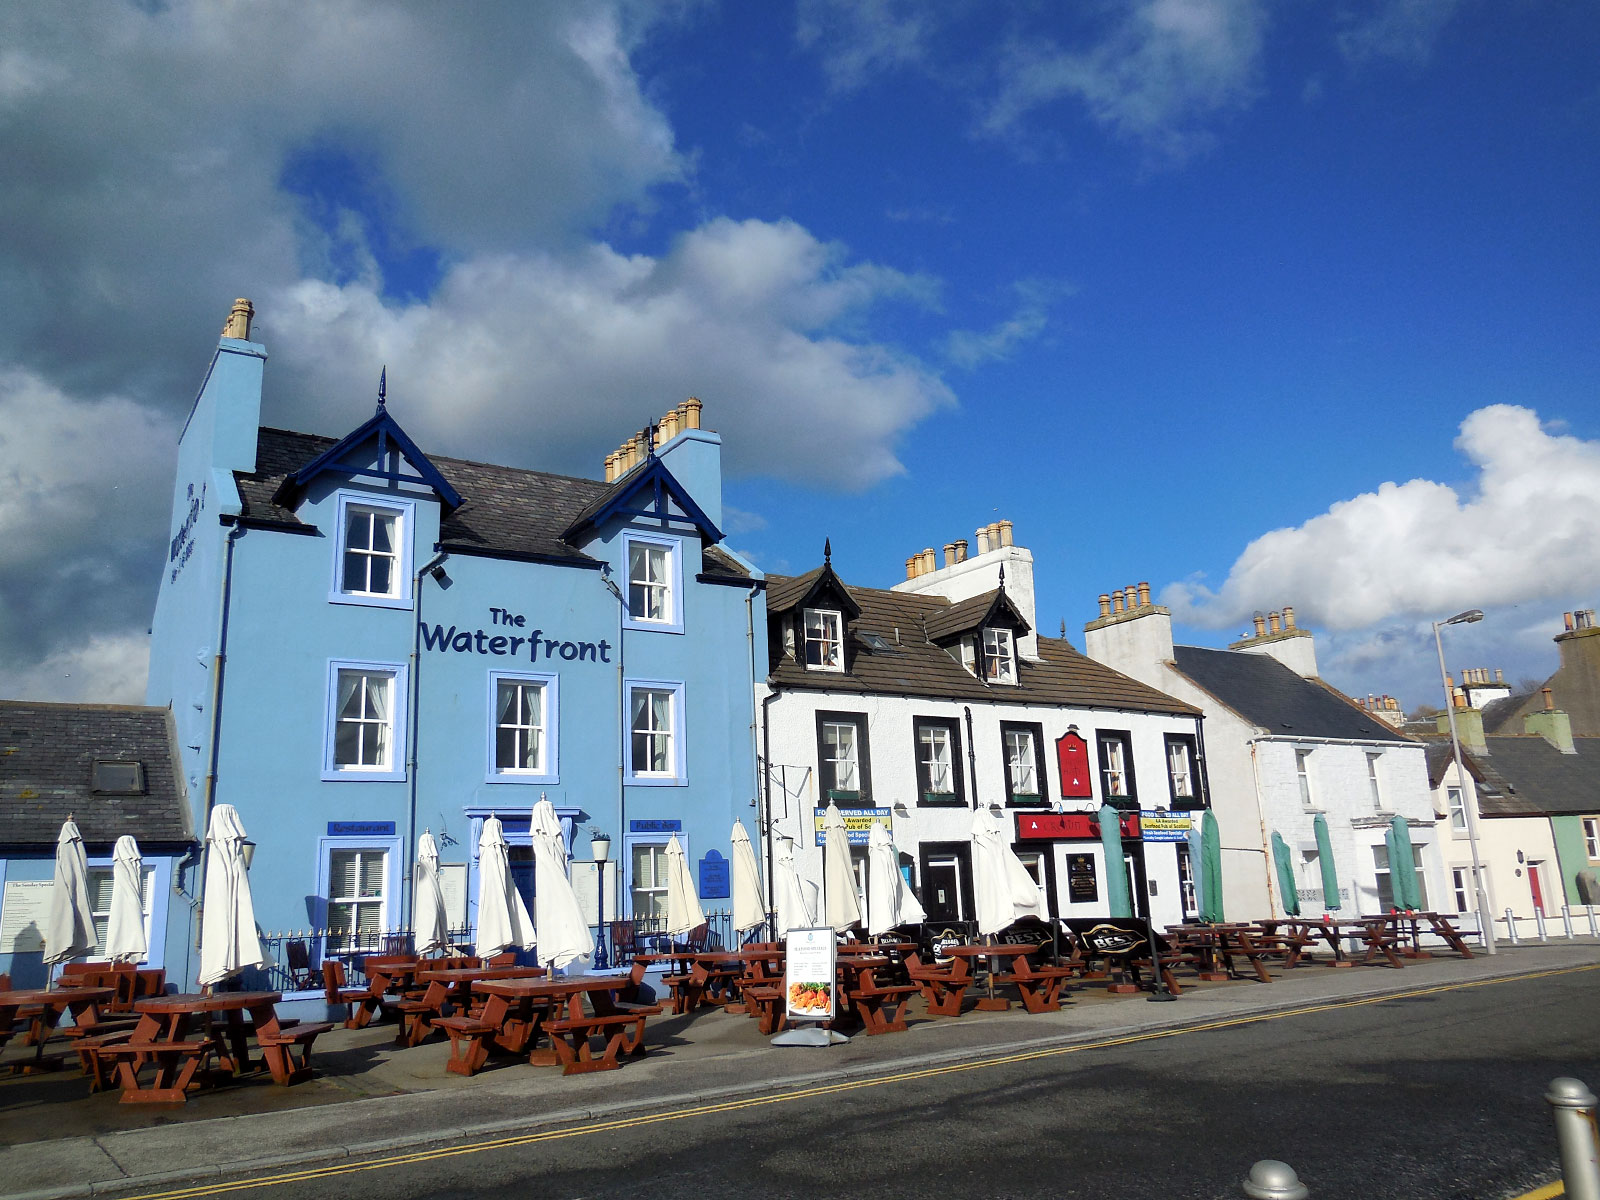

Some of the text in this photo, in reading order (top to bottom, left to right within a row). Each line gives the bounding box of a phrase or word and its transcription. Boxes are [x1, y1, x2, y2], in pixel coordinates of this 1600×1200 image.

[489, 607, 526, 627] The
[420, 621, 612, 663] Waterfront
[333, 822, 389, 833] Restaurant
[636, 821, 660, 830] Public
[1004, 931, 1042, 945] BEST
